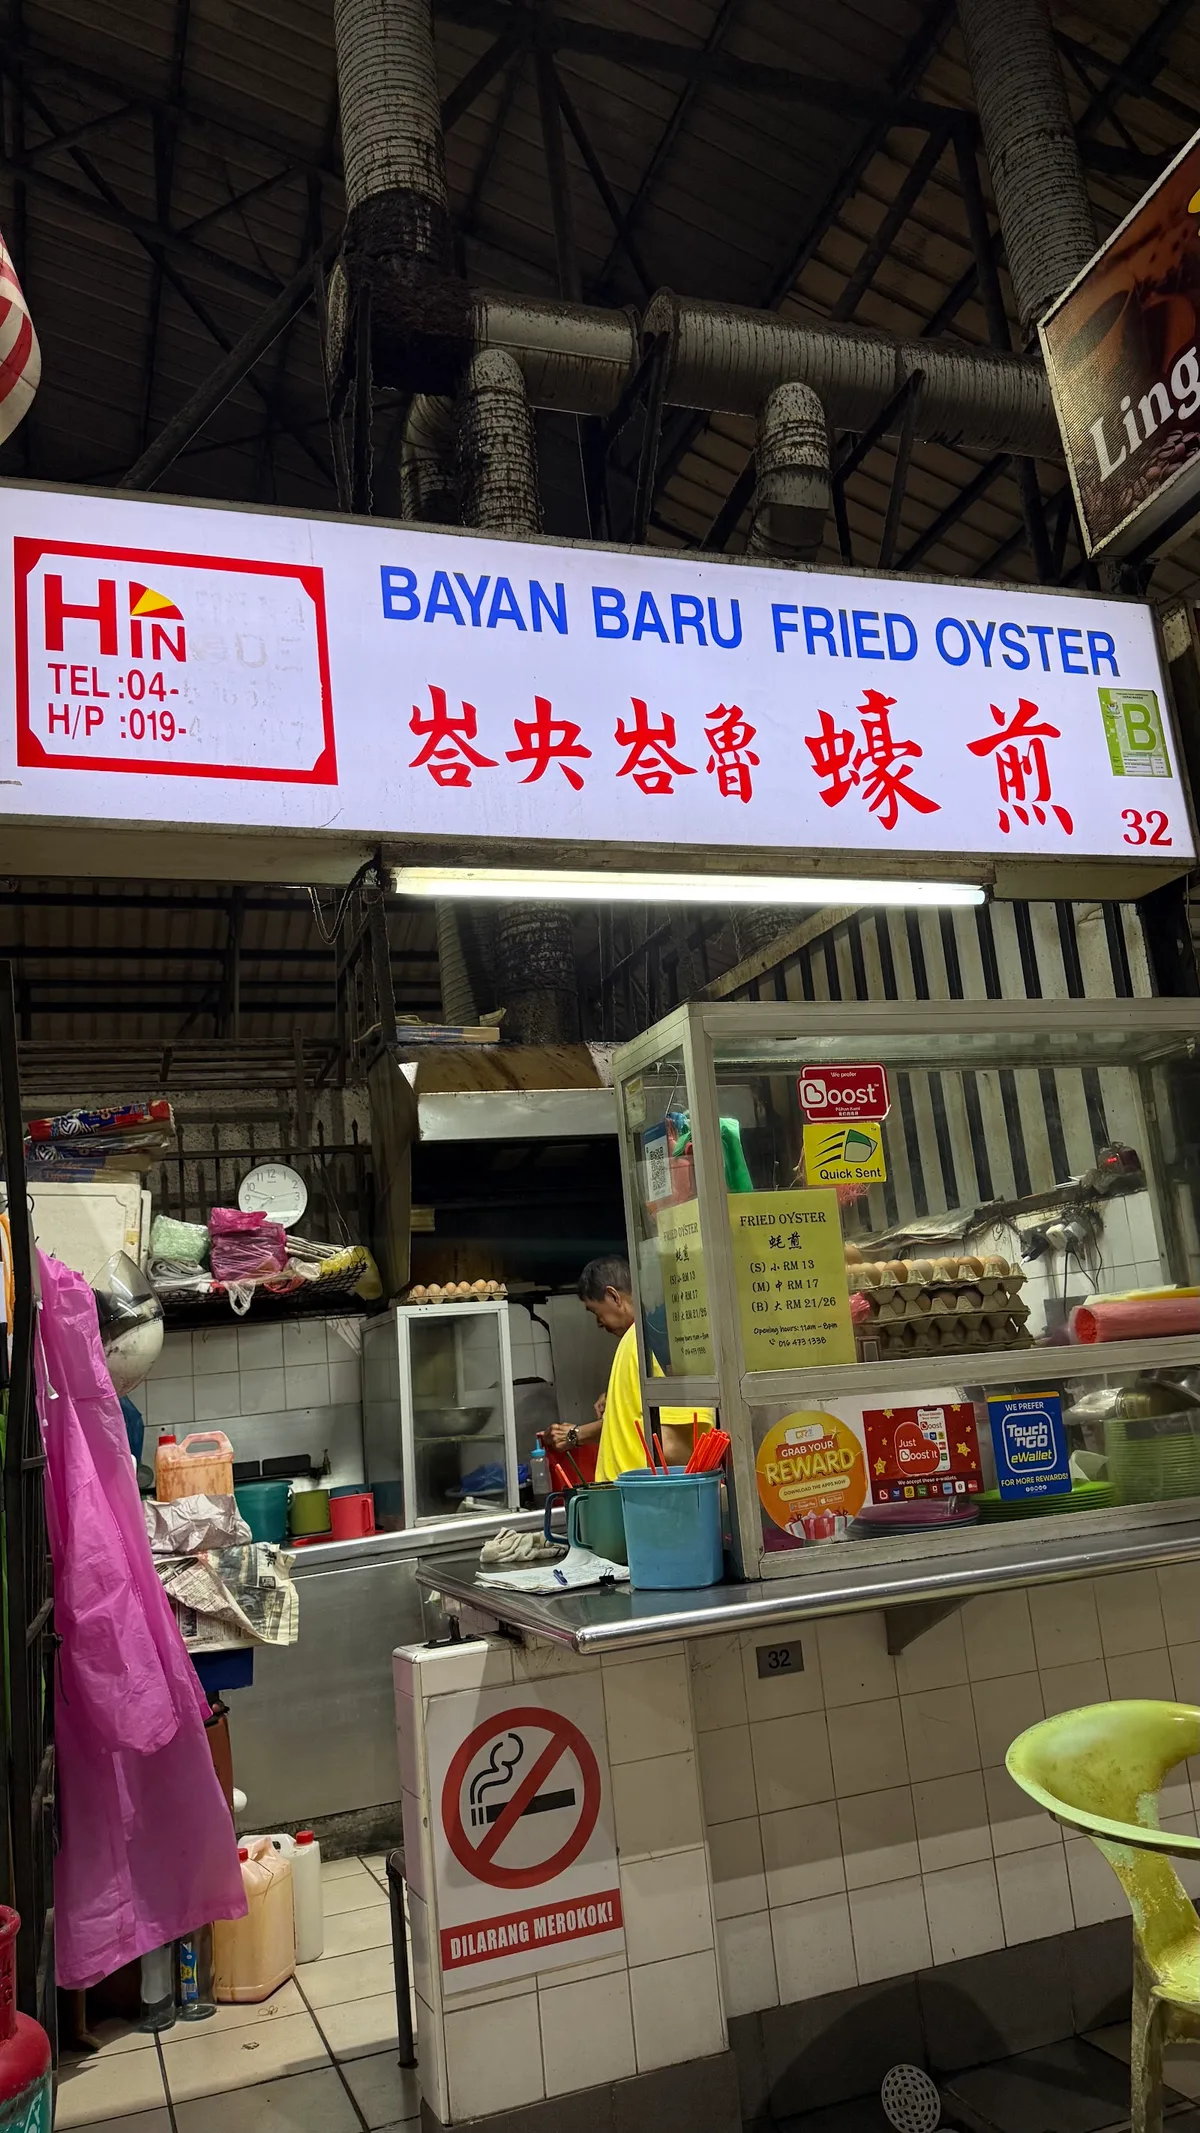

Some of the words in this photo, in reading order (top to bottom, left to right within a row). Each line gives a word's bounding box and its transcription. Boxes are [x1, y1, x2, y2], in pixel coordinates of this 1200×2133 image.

[381, 565, 569, 635] BAYAN
[592, 586, 743, 649] BARU
[771, 603, 918, 661] FRIED
[936, 617, 1121, 677] OYSTER
[1122, 703, 1157, 751] B
[1121, 808, 1173, 847] 32
[800, 1082, 877, 1107] Boost
[820, 1168, 852, 1180] Quick
[855, 1167, 881, 1178] Sent
[739, 1214, 776, 1227] FRIED
[779, 1212, 827, 1224] OYSTER
[750, 1261, 766, 1273] (S)
[783, 1261, 799, 1271] RM
[802, 1260, 815, 1270] 13
[752, 1281, 770, 1293] (M)
[787, 1280, 803, 1290] RM
[806, 1279, 819, 1289] 17
[751, 1301, 769, 1313] (B)
[773, 1301, 782, 1311] 大
[786, 1300, 802, 1310] RM
[804, 1297, 836, 1309] 21/26
[753, 1326, 779, 1335] Opening
[780, 1325, 799, 1333] hours:
[778, 1339, 791, 1347] 016
[792, 1338, 806, 1346] 473
[808, 1336, 827, 1345] 1338
[1018, 1401, 1044, 1410] PREFER
[1006, 1422, 1047, 1437] Touch
[781, 1446, 807, 1457] GRAB
[808, 1440, 834, 1452] YOUR
[899, 1439, 917, 1448] Just
[1011, 1449, 1052, 1464] eWallet
[764, 1448, 855, 1486] REWARD
[1001, 1479, 1015, 1487] FOR
[1015, 1477, 1034, 1485] MORE
[1035, 1472, 1068, 1482] REWARDS!
[783, 1487, 812, 1496] DOWNLOAD
[767, 1649, 792, 1669] 32
[450, 1920, 530, 1960] DILARANG
[533, 1901, 614, 1941] MEROKOK!
